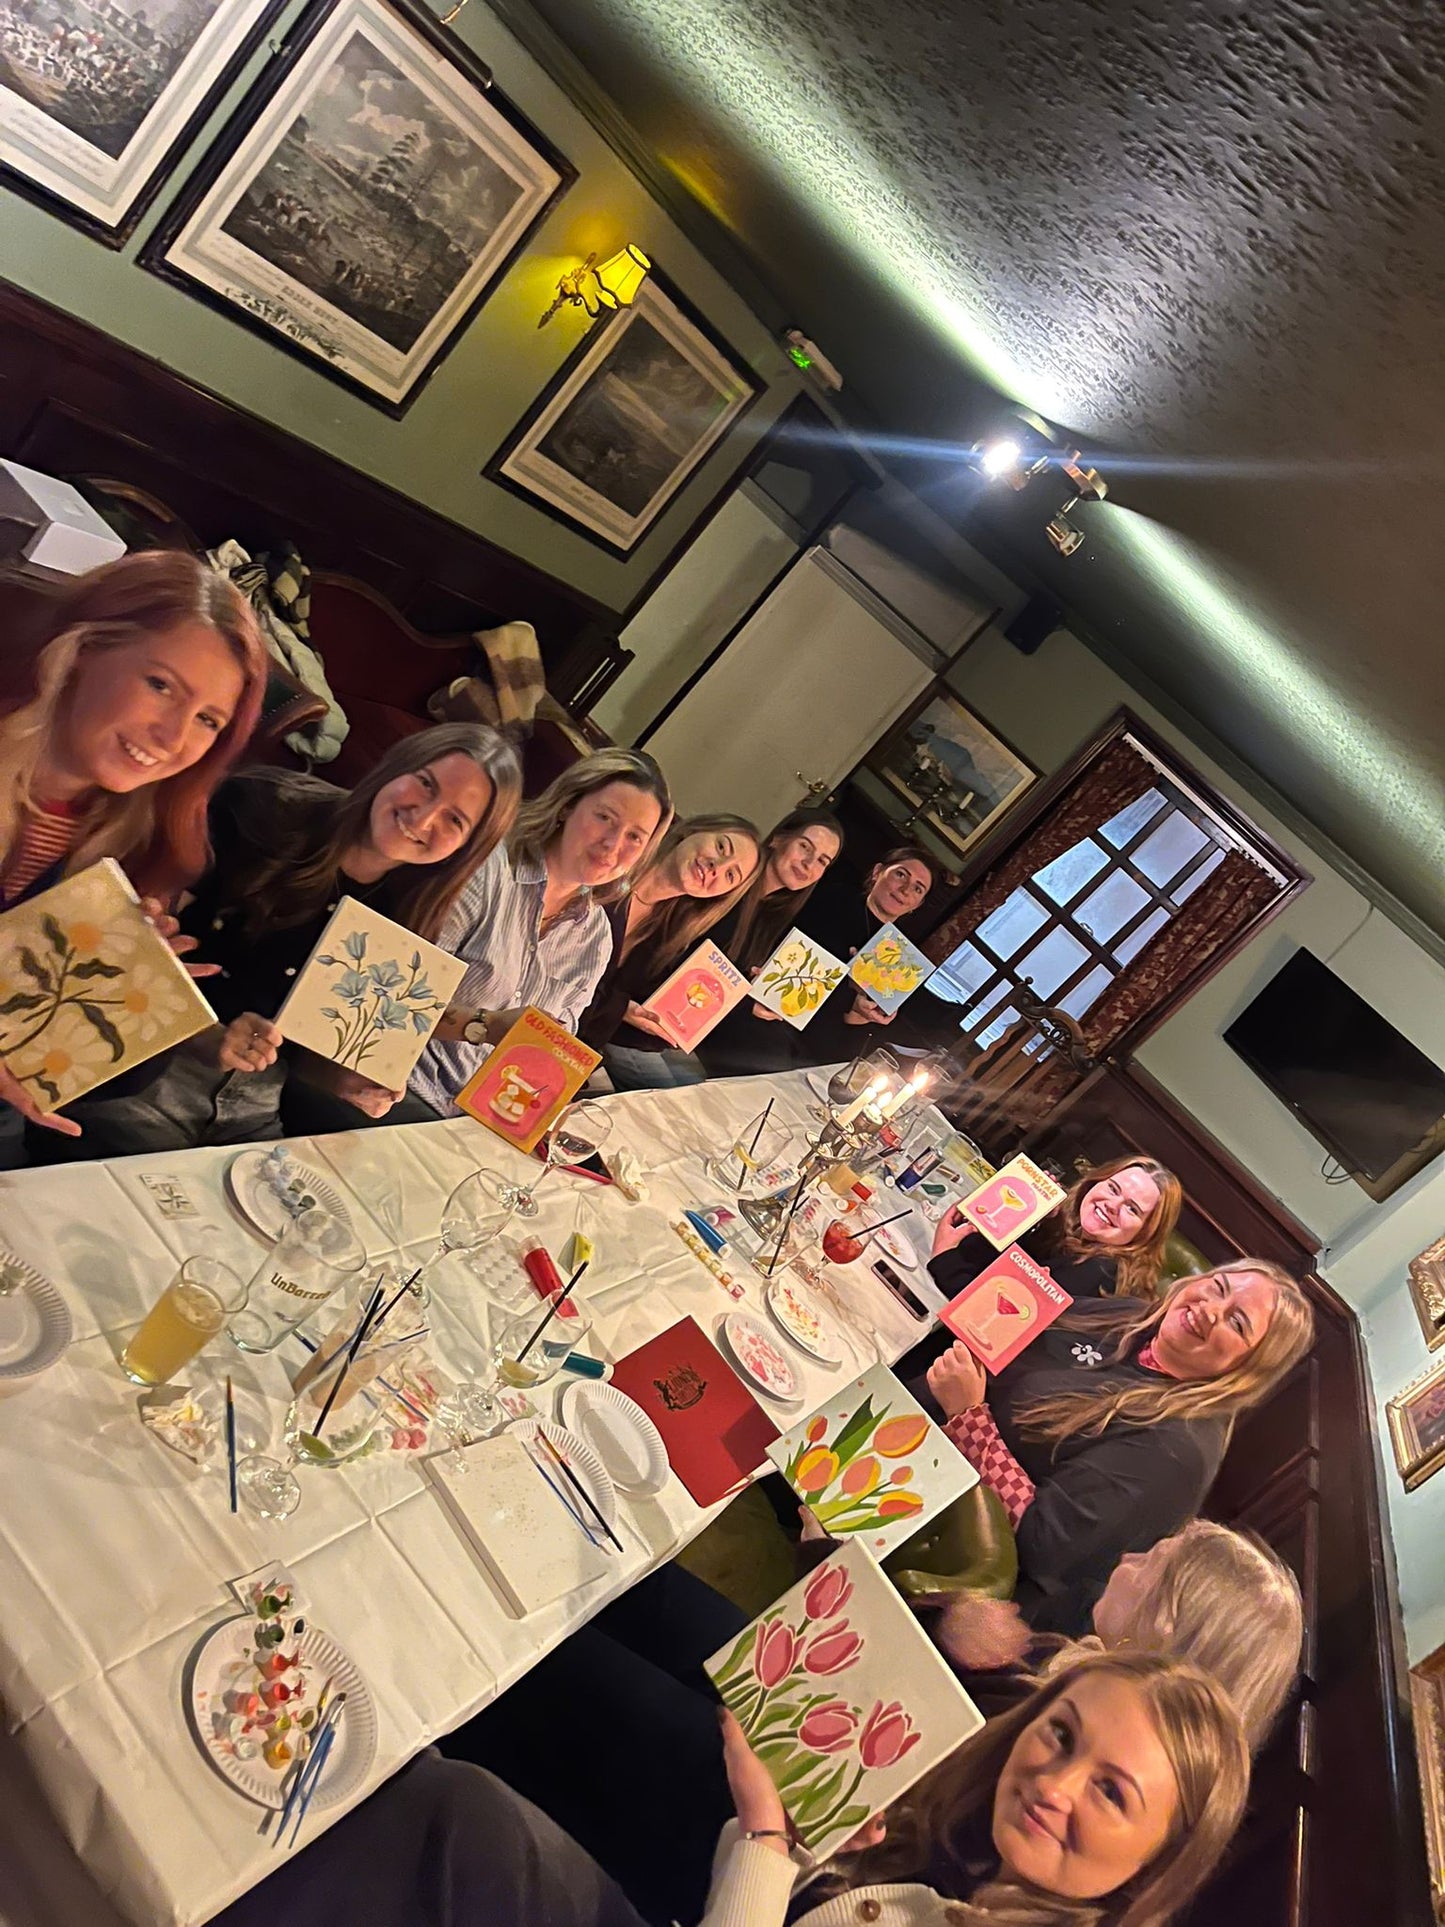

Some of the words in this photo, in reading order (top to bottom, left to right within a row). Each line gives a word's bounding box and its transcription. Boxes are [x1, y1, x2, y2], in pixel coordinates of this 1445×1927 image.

[708, 951, 742, 987] SPRITZ
[525, 1013, 545, 1031] OLD
[543, 1027, 594, 1066] FASHIONED
[552, 1047, 585, 1075] COCKTAIL
[1017, 1158, 1058, 1198] PORNSTAR
[1009, 1251, 1066, 1305] COSMOPOLITAN
